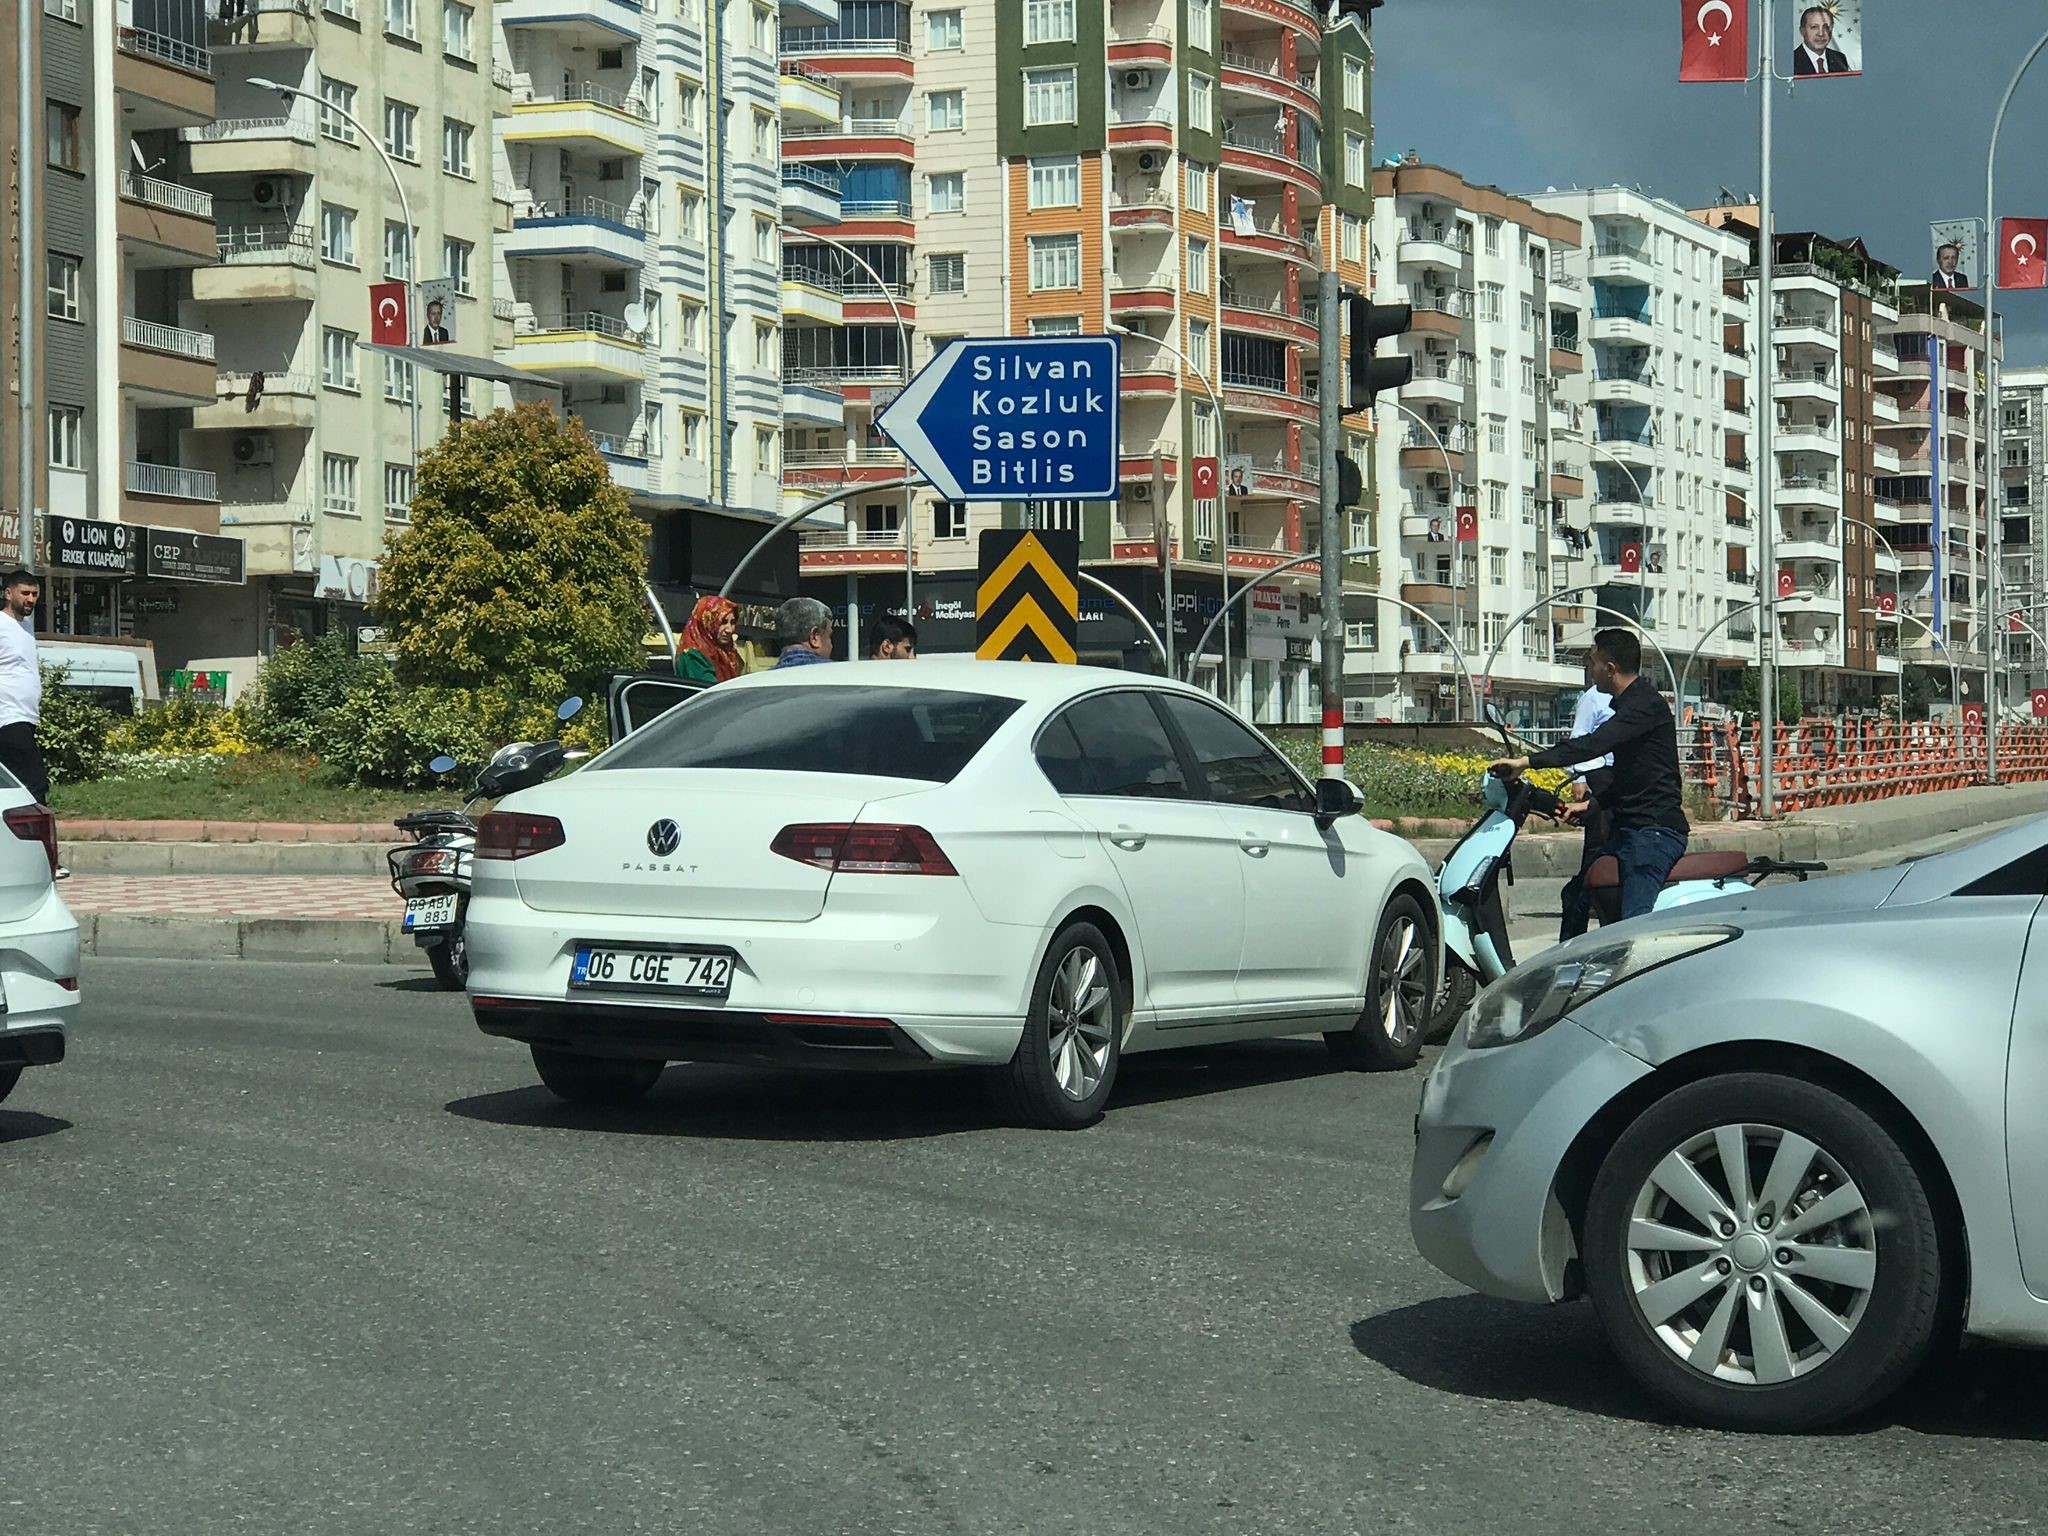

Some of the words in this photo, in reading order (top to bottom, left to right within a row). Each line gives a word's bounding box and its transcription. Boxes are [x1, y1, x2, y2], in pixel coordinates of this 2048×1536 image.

[973, 355, 1091, 381] Silvan
[972, 388, 1104, 415] Kozluk
[972, 424, 1087, 450] Sason
[972, 458, 1075, 484] Bitlis
[81, 524, 107, 546] LİON
[62, 549, 85, 565] ERKEK
[88, 550, 126, 569] KUAFÖRÜ
[154, 545, 180, 560] CEP
[935, 600, 961, 613] İnegöl
[935, 611, 975, 620] Mobilyası
[622, 863, 698, 873] PASSAT
[424, 911, 448, 923] 883
[588, 951, 616, 979] 06
[630, 954, 673, 983] CGE
[685, 957, 729, 986] 742
